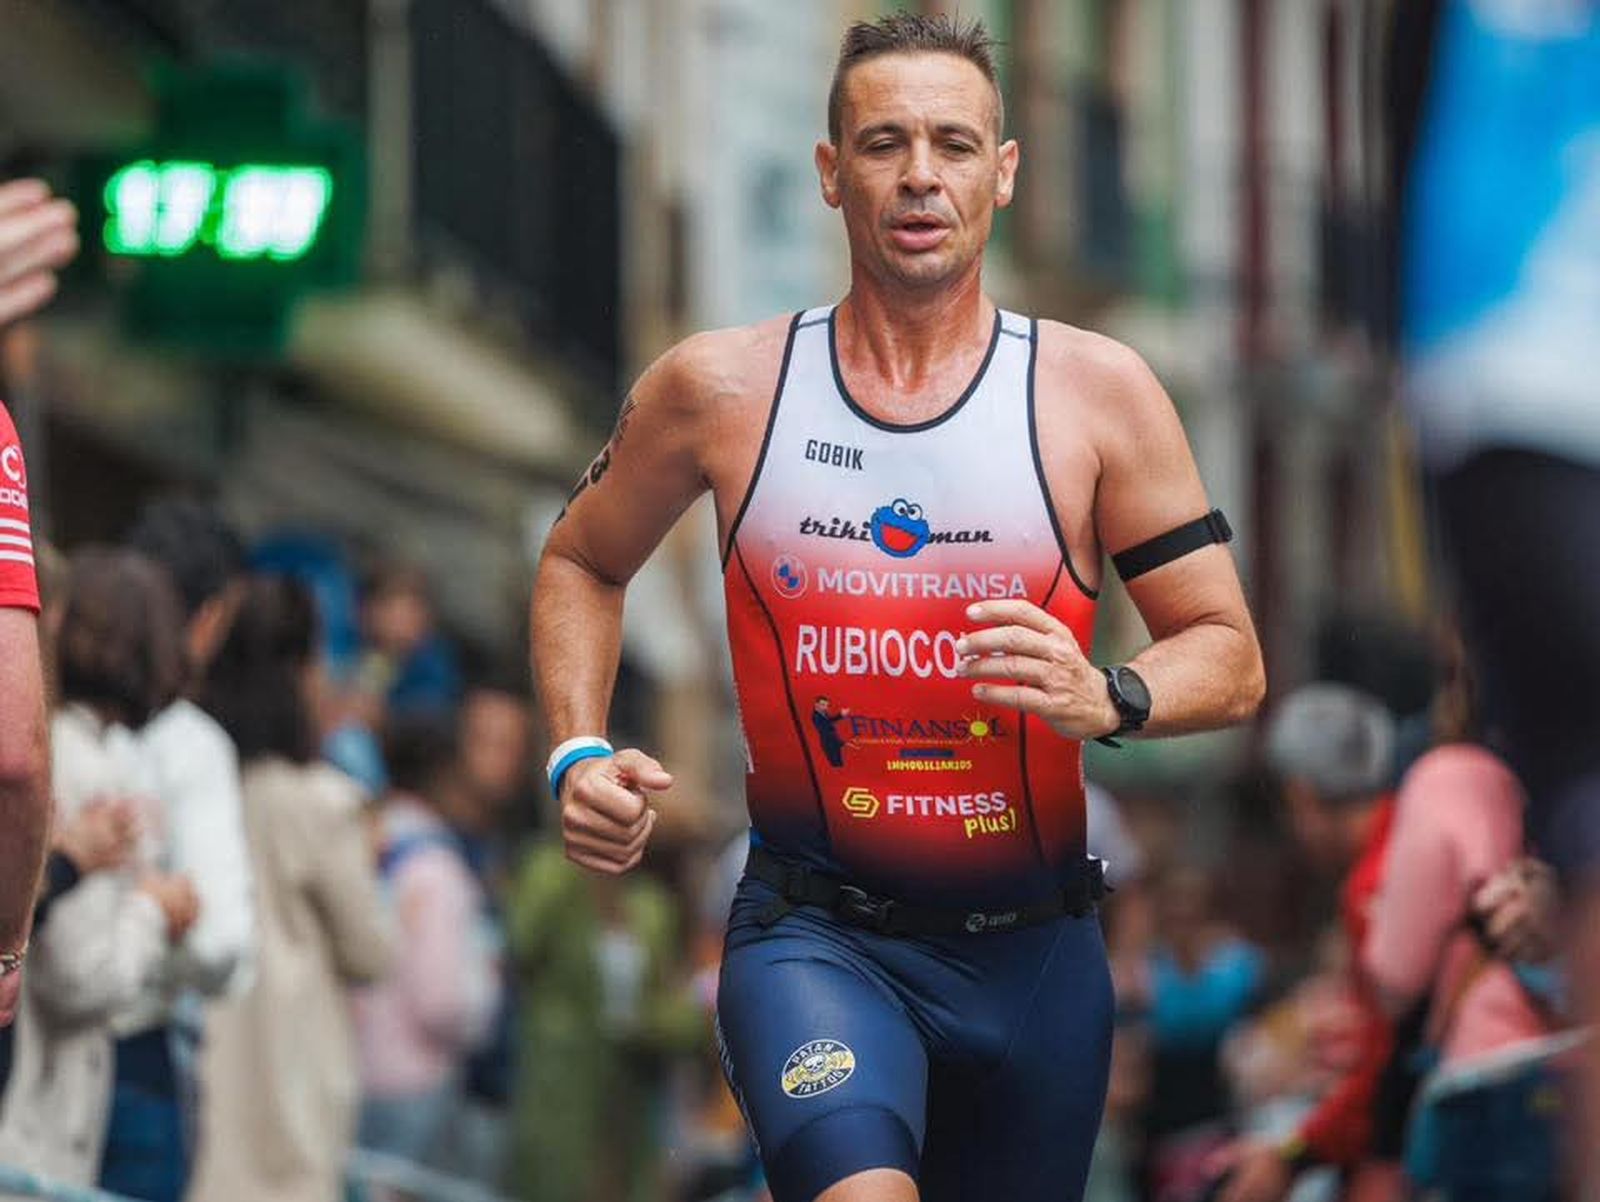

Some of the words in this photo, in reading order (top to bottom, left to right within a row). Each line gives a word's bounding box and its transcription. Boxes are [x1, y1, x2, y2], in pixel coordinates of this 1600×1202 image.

[804, 438, 864, 471] GOBIK
[799, 517, 871, 543] triki
[928, 528, 993, 544] man
[816, 567, 1028, 600] MOVITRANSA
[794, 624, 1005, 679] RUBIOCO
[886, 791, 1007, 816] FITNESS
